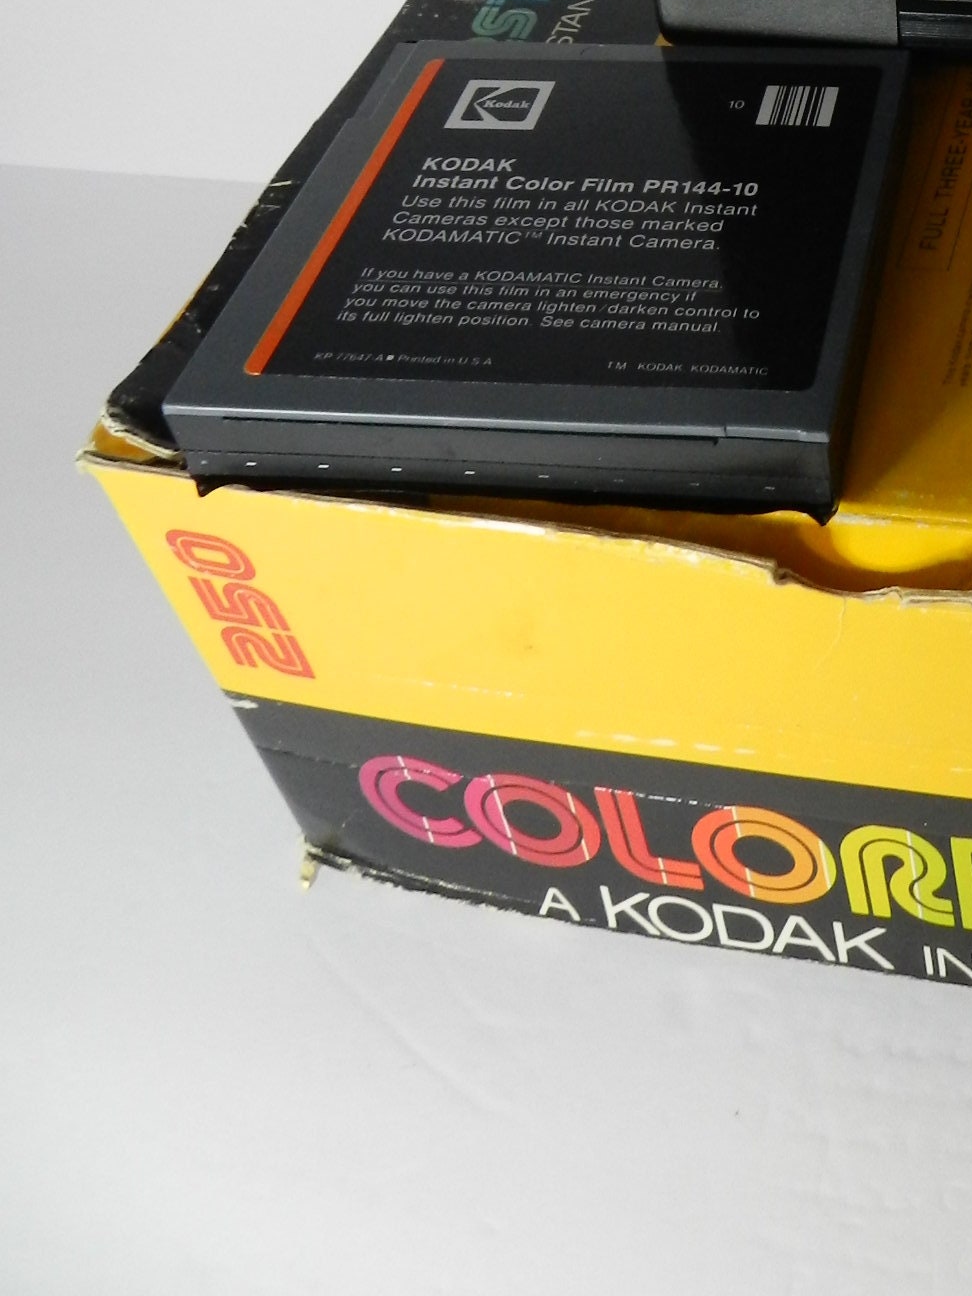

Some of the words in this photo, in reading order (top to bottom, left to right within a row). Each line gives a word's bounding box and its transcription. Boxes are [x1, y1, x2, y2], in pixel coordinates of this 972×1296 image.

[483, 98, 532, 110] Kodak
[729, 100, 746, 110] 10
[421, 157, 517, 172] KODAK
[412, 174, 499, 190] Instant
[505, 176, 575, 192] Color
[580, 178, 635, 193] Film
[642, 179, 760, 196] PR144-10
[401, 195, 442, 208] Use
[448, 195, 487, 209] this
[493, 197, 531, 210] film
[537, 198, 557, 211] in
[563, 199, 589, 212] all
[595, 200, 677, 214] KODAK
[684, 202, 757, 216] Instant
[392, 211, 488, 226] Cameras
[494, 214, 568, 230] except
[575, 216, 634, 230] those
[641, 219, 724, 233] marked
[918, 208, 950, 252] FULL
[546, 232, 622, 248] Instant
[629, 234, 720, 250] Camera.
[360, 267, 376, 278] If
[376, 270, 408, 281] you
[413, 269, 454, 281] have
[458, 271, 469, 281] a
[474, 270, 582, 284] KODAMATIC
[587, 273, 645, 286] Instant
[352, 283, 384, 294] you
[389, 284, 421, 294] can
[427, 285, 457, 295] use
[462, 284, 493, 296] this
[499, 285, 529, 297] film
[534, 287, 550, 298] in
[555, 289, 577, 298] an
[583, 289, 680, 303] emergency
[685, 290, 697, 302] if
[344, 297, 377, 309] you
[381, 298, 429, 309] move
[434, 298, 462, 310] the
[466, 301, 532, 312] camera
[674, 306, 738, 319] control
[743, 308, 760, 319] to
[336, 310, 358, 322] its
[362, 310, 390, 322] full
[393, 312, 453, 325] lighten
[540, 315, 574, 328] See
[579, 318, 646, 331] camera
[637, 362, 683, 372] KODAK
[690, 364, 768, 376] KODAMATIC
[165, 529, 316, 680] 250
[539, 887, 581, 922] A
[600, 885, 895, 971] KODAK
